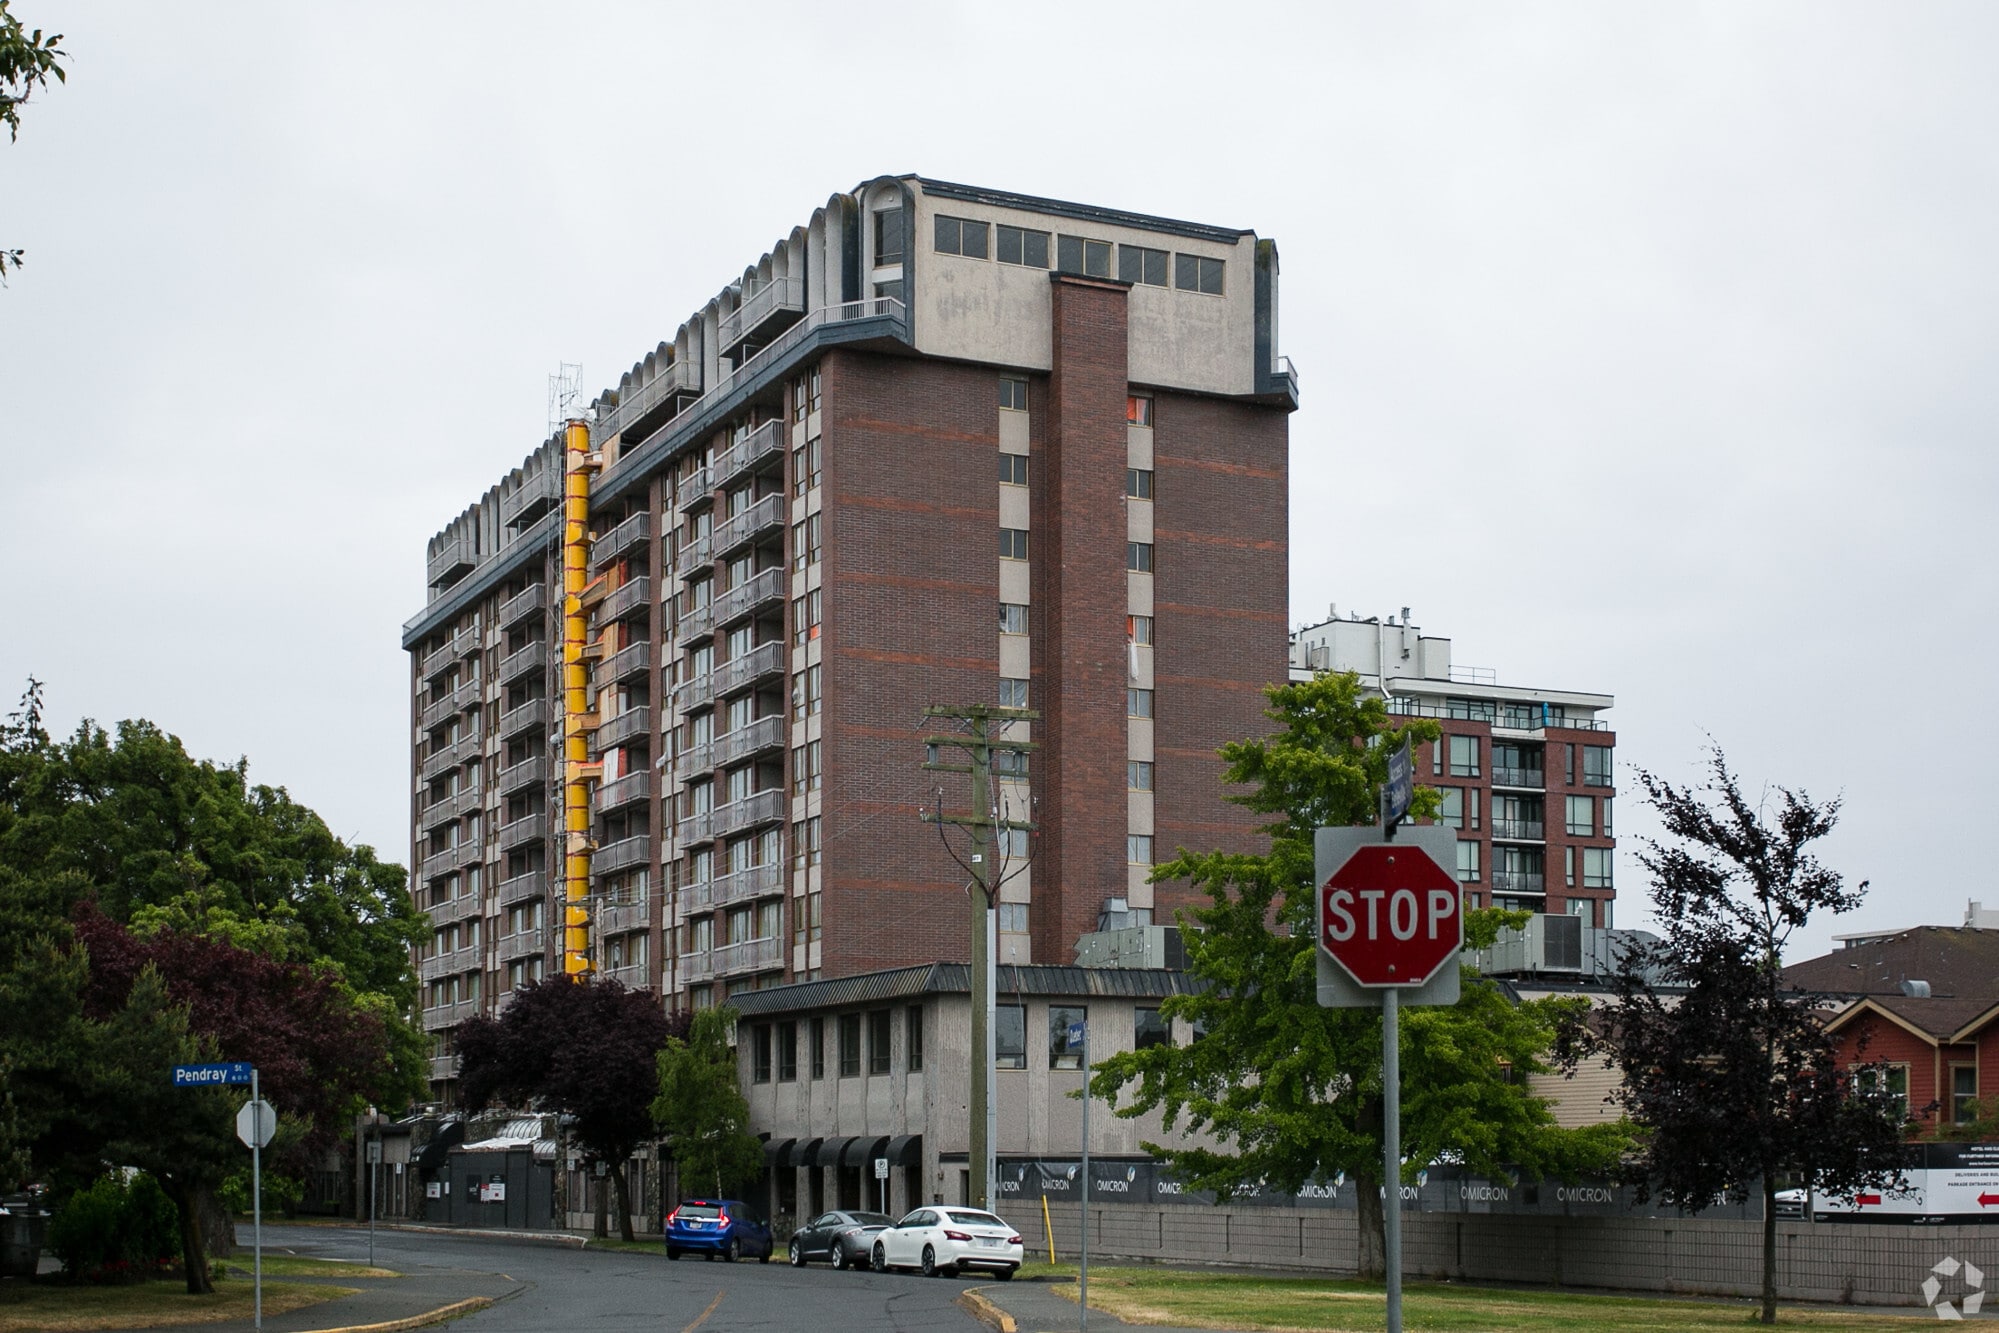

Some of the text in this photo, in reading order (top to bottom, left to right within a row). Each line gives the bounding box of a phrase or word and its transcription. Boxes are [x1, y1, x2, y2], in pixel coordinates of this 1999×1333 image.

[1328, 889, 1455, 942] STOP
[176, 1064, 242, 1083] Pendray St
[1042, 1179, 1069, 1190] OMICRON
[1097, 1179, 1128, 1192] OMICRON
[1460, 1186, 1508, 1201] OMICRON
[1556, 1186, 1612, 1202] OMICRON
